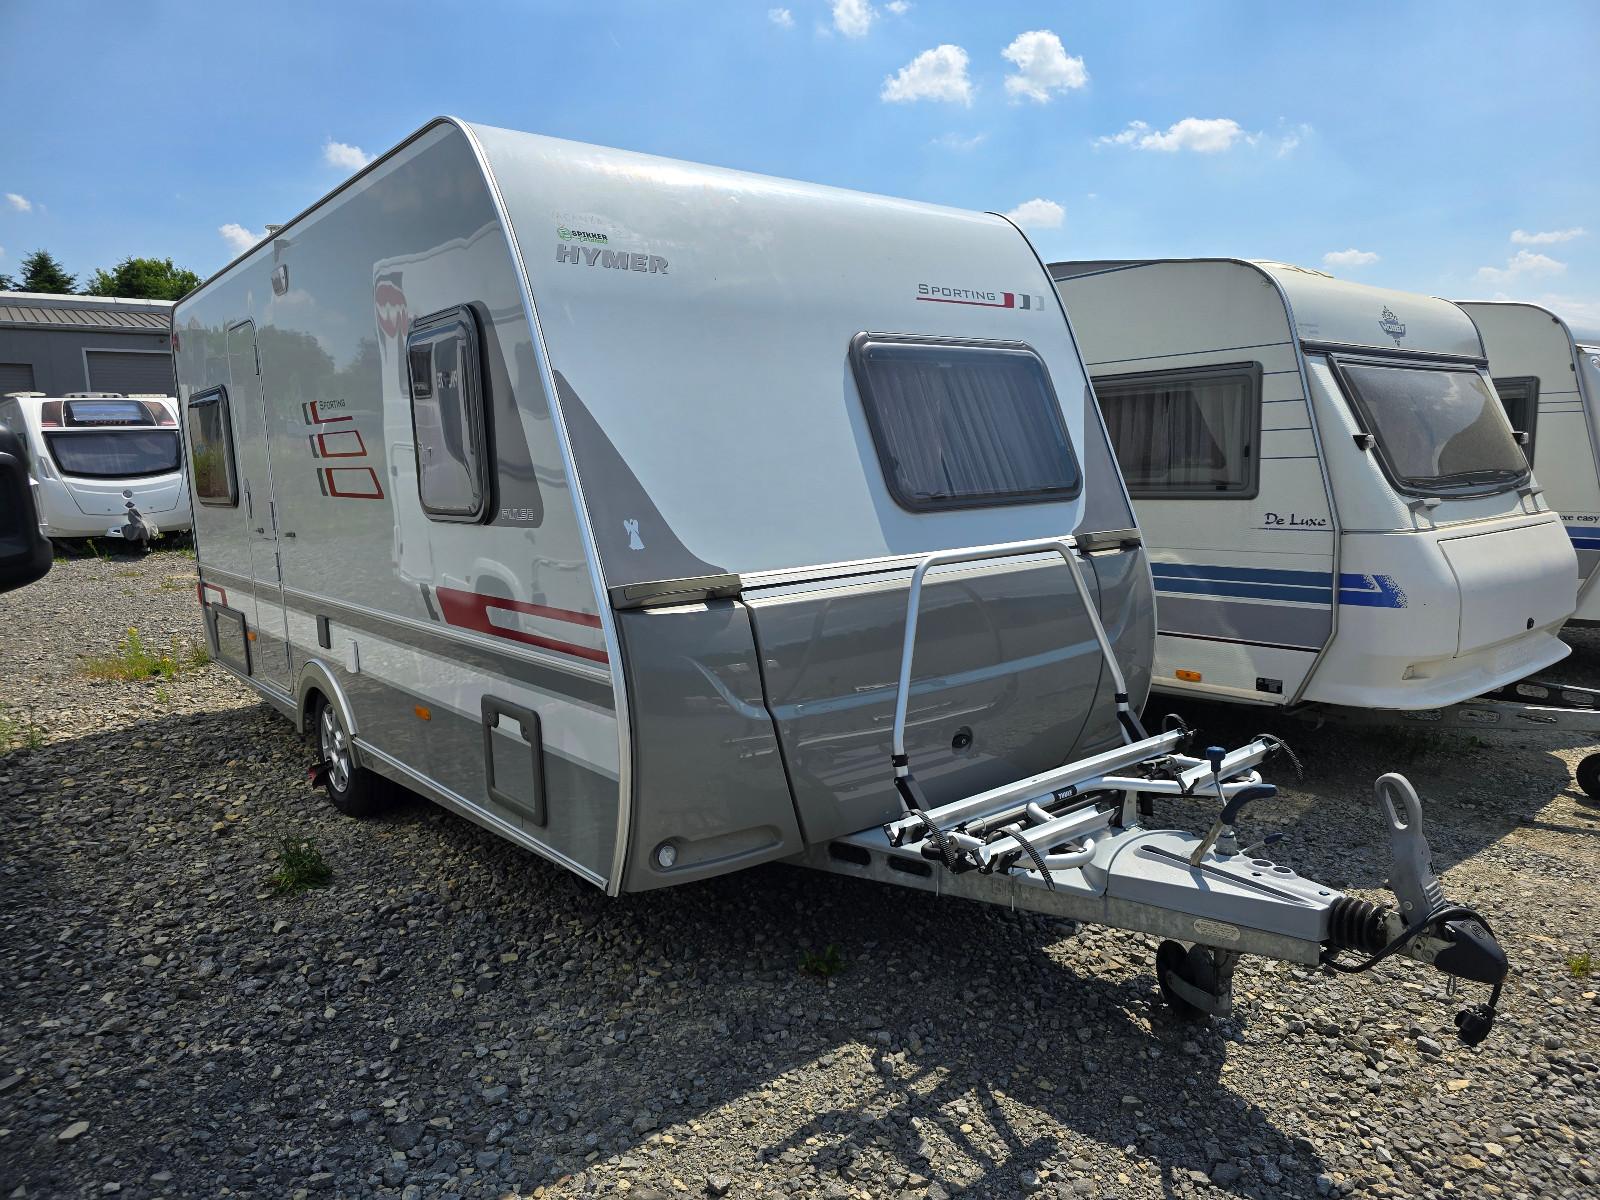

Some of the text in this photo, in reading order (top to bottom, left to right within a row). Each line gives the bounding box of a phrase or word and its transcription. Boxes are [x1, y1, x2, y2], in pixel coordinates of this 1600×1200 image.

[571, 230, 608, 241] SPIKKER
[556, 243, 669, 275] HYMER
[918, 283, 996, 301] SPORTING
[501, 508, 534, 521] PULSE
[1264, 512, 1327, 527] De Luxe
[1577, 515, 1599, 524] easy
